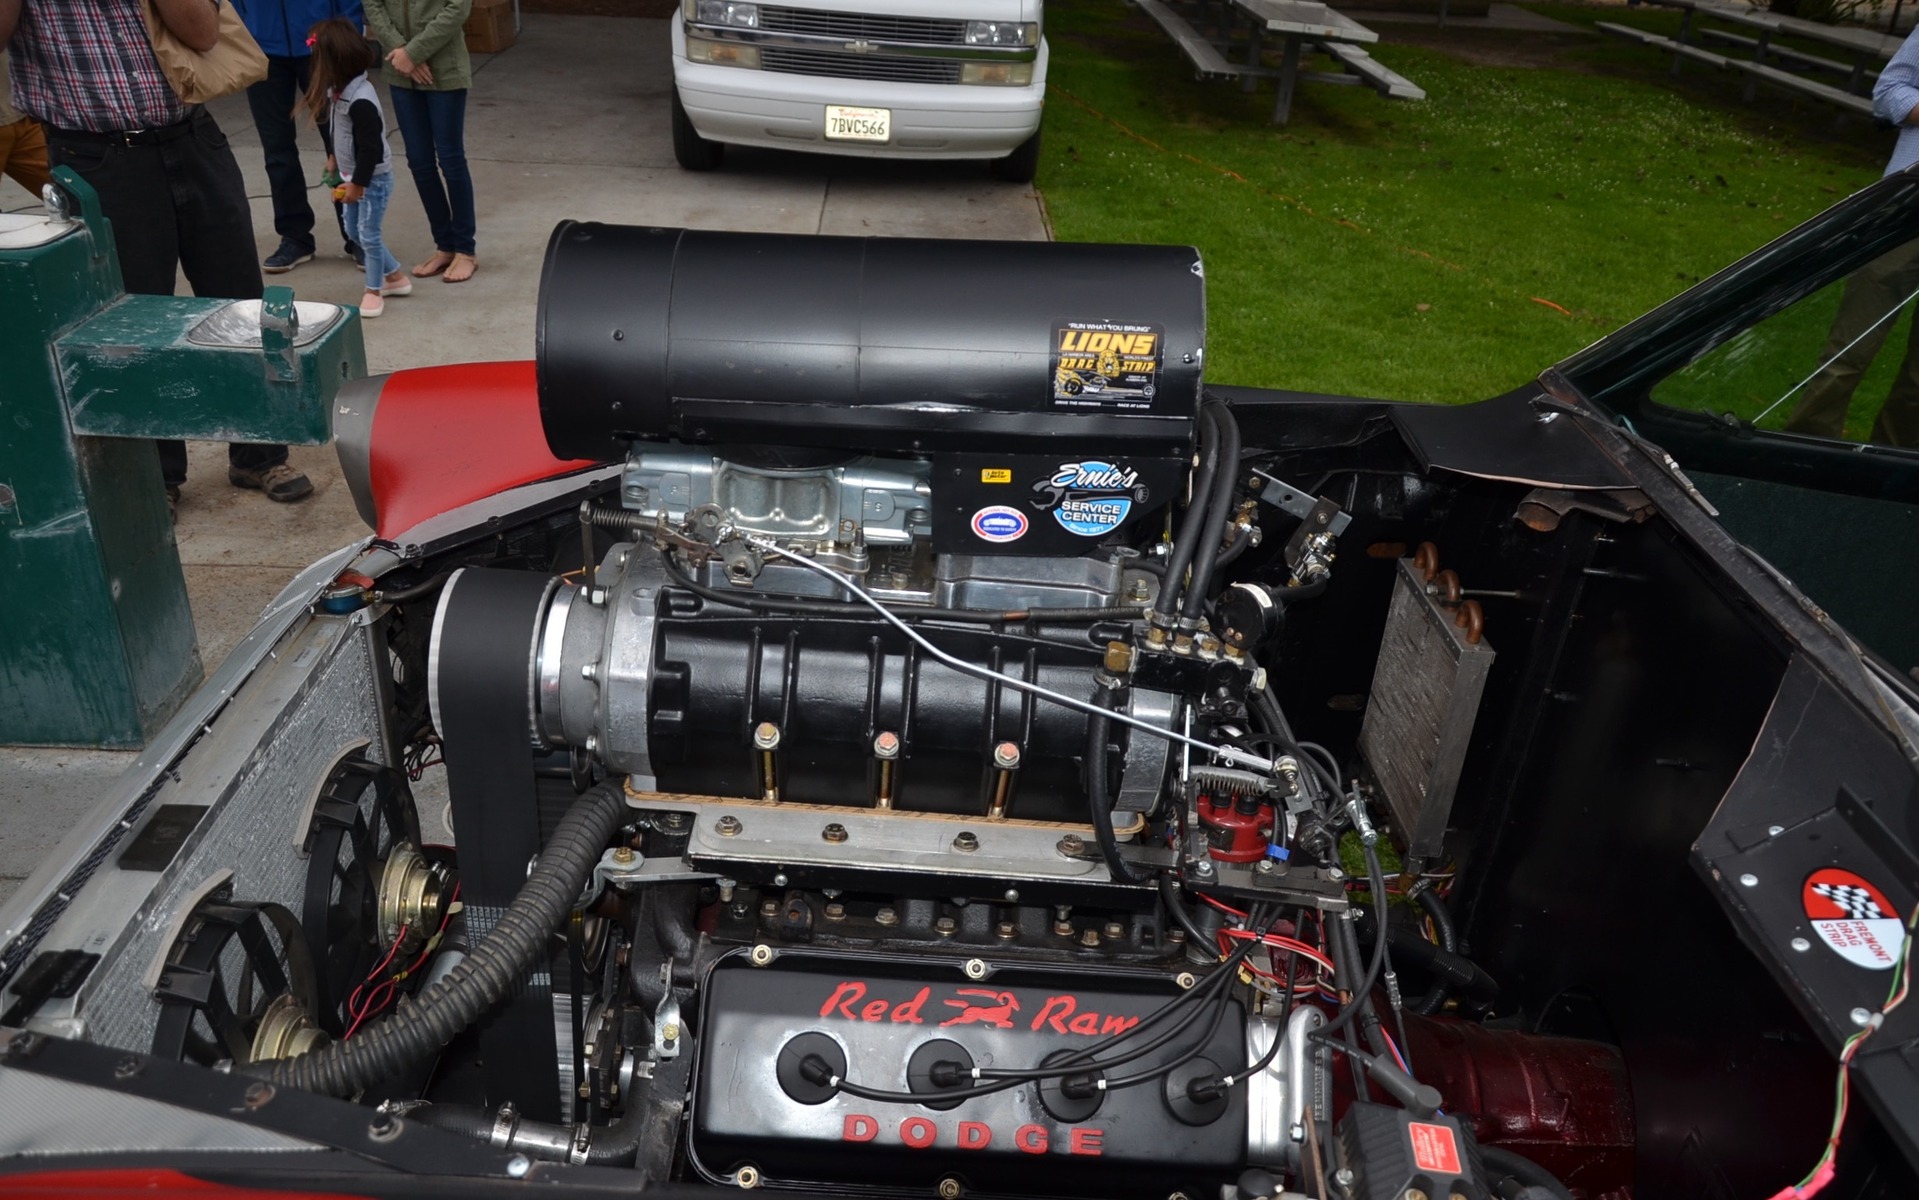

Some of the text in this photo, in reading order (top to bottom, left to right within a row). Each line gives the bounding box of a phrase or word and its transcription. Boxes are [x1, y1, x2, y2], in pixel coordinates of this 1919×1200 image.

[831, 118, 885, 135] 7BVC566
[1060, 331, 1155, 355] LIONS
[1060, 357, 1155, 372] DRAG STRIP
[1050, 462, 1139, 488] Ernie's
[1061, 501, 1122, 515] SERVICE
[1061, 511, 1118, 524] CENTER
[1069, 522, 1088, 533] Since
[1820, 923, 1847, 949] STRIP
[1836, 922, 1863, 948] DRAG
[1851, 920, 1893, 963] FREMONT
[819, 981, 931, 1024] Red
[842, 1113, 1105, 1157] DODGE
